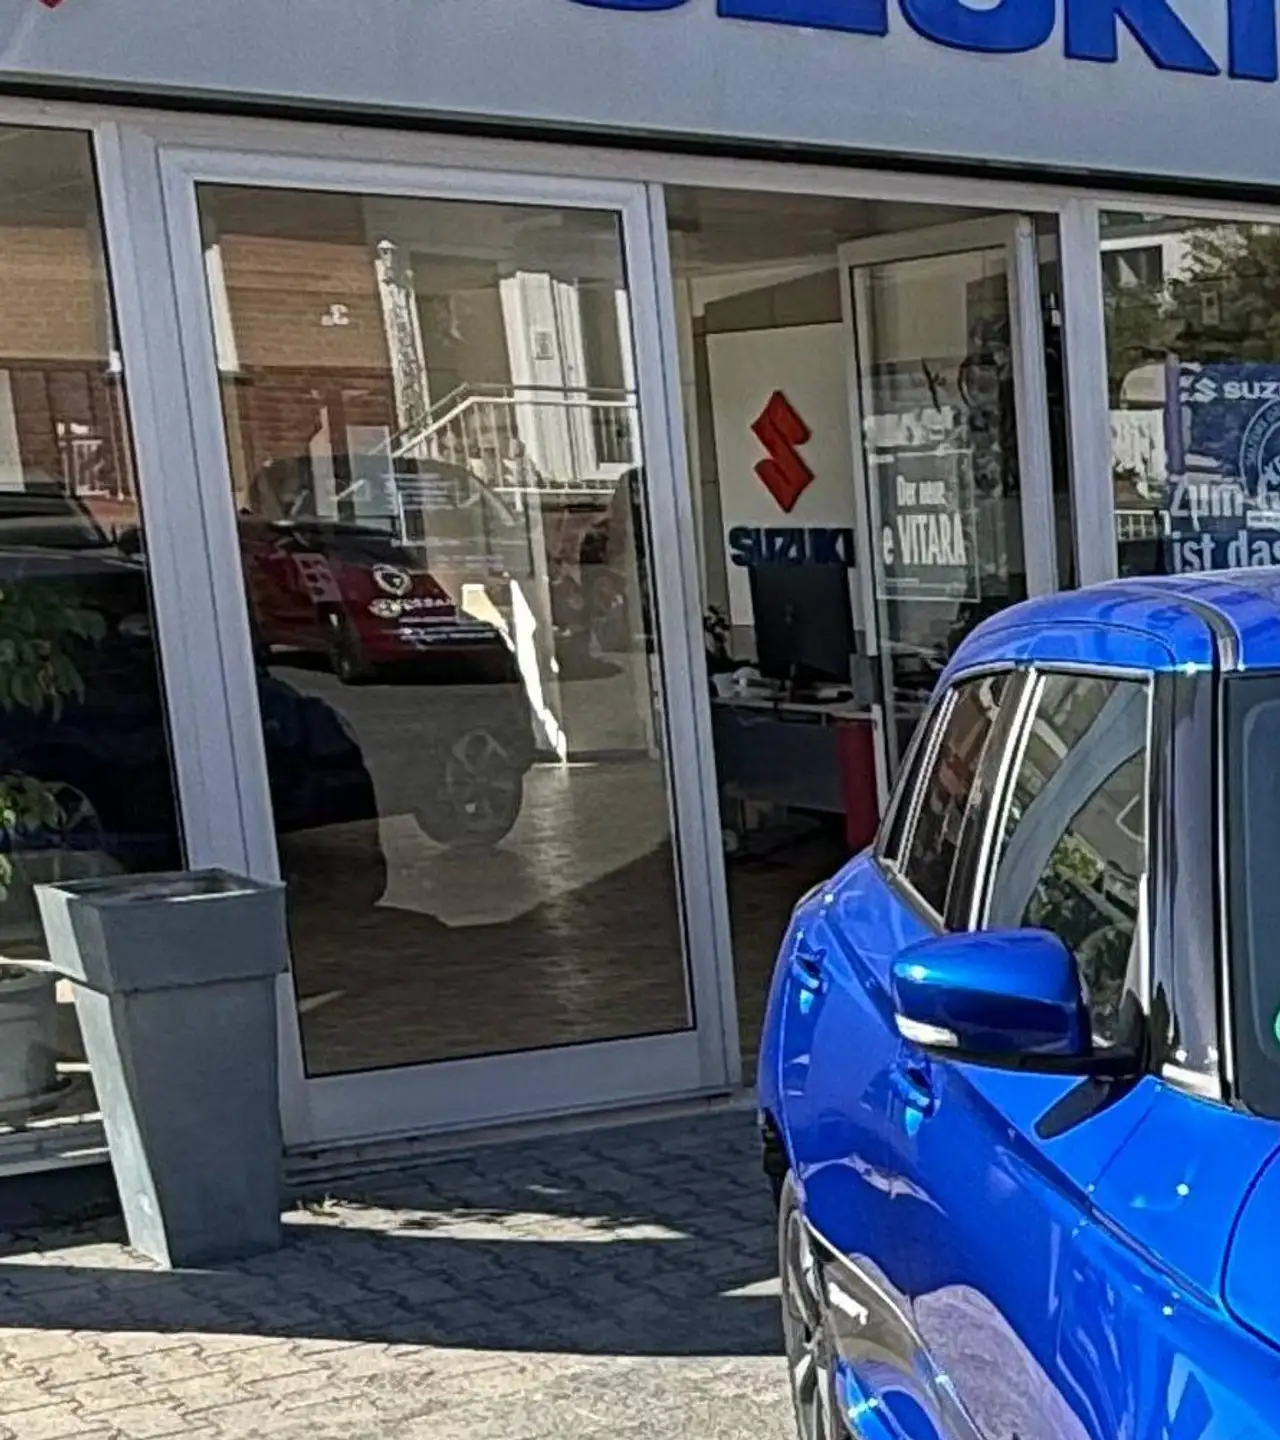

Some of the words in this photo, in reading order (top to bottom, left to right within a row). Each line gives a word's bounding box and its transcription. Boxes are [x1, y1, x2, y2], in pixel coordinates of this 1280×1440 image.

[729, 527, 855, 567] SUZUKI
[882, 524, 894, 565] e
[897, 512, 968, 566] VITARA
[1172, 531, 1216, 573] ist
